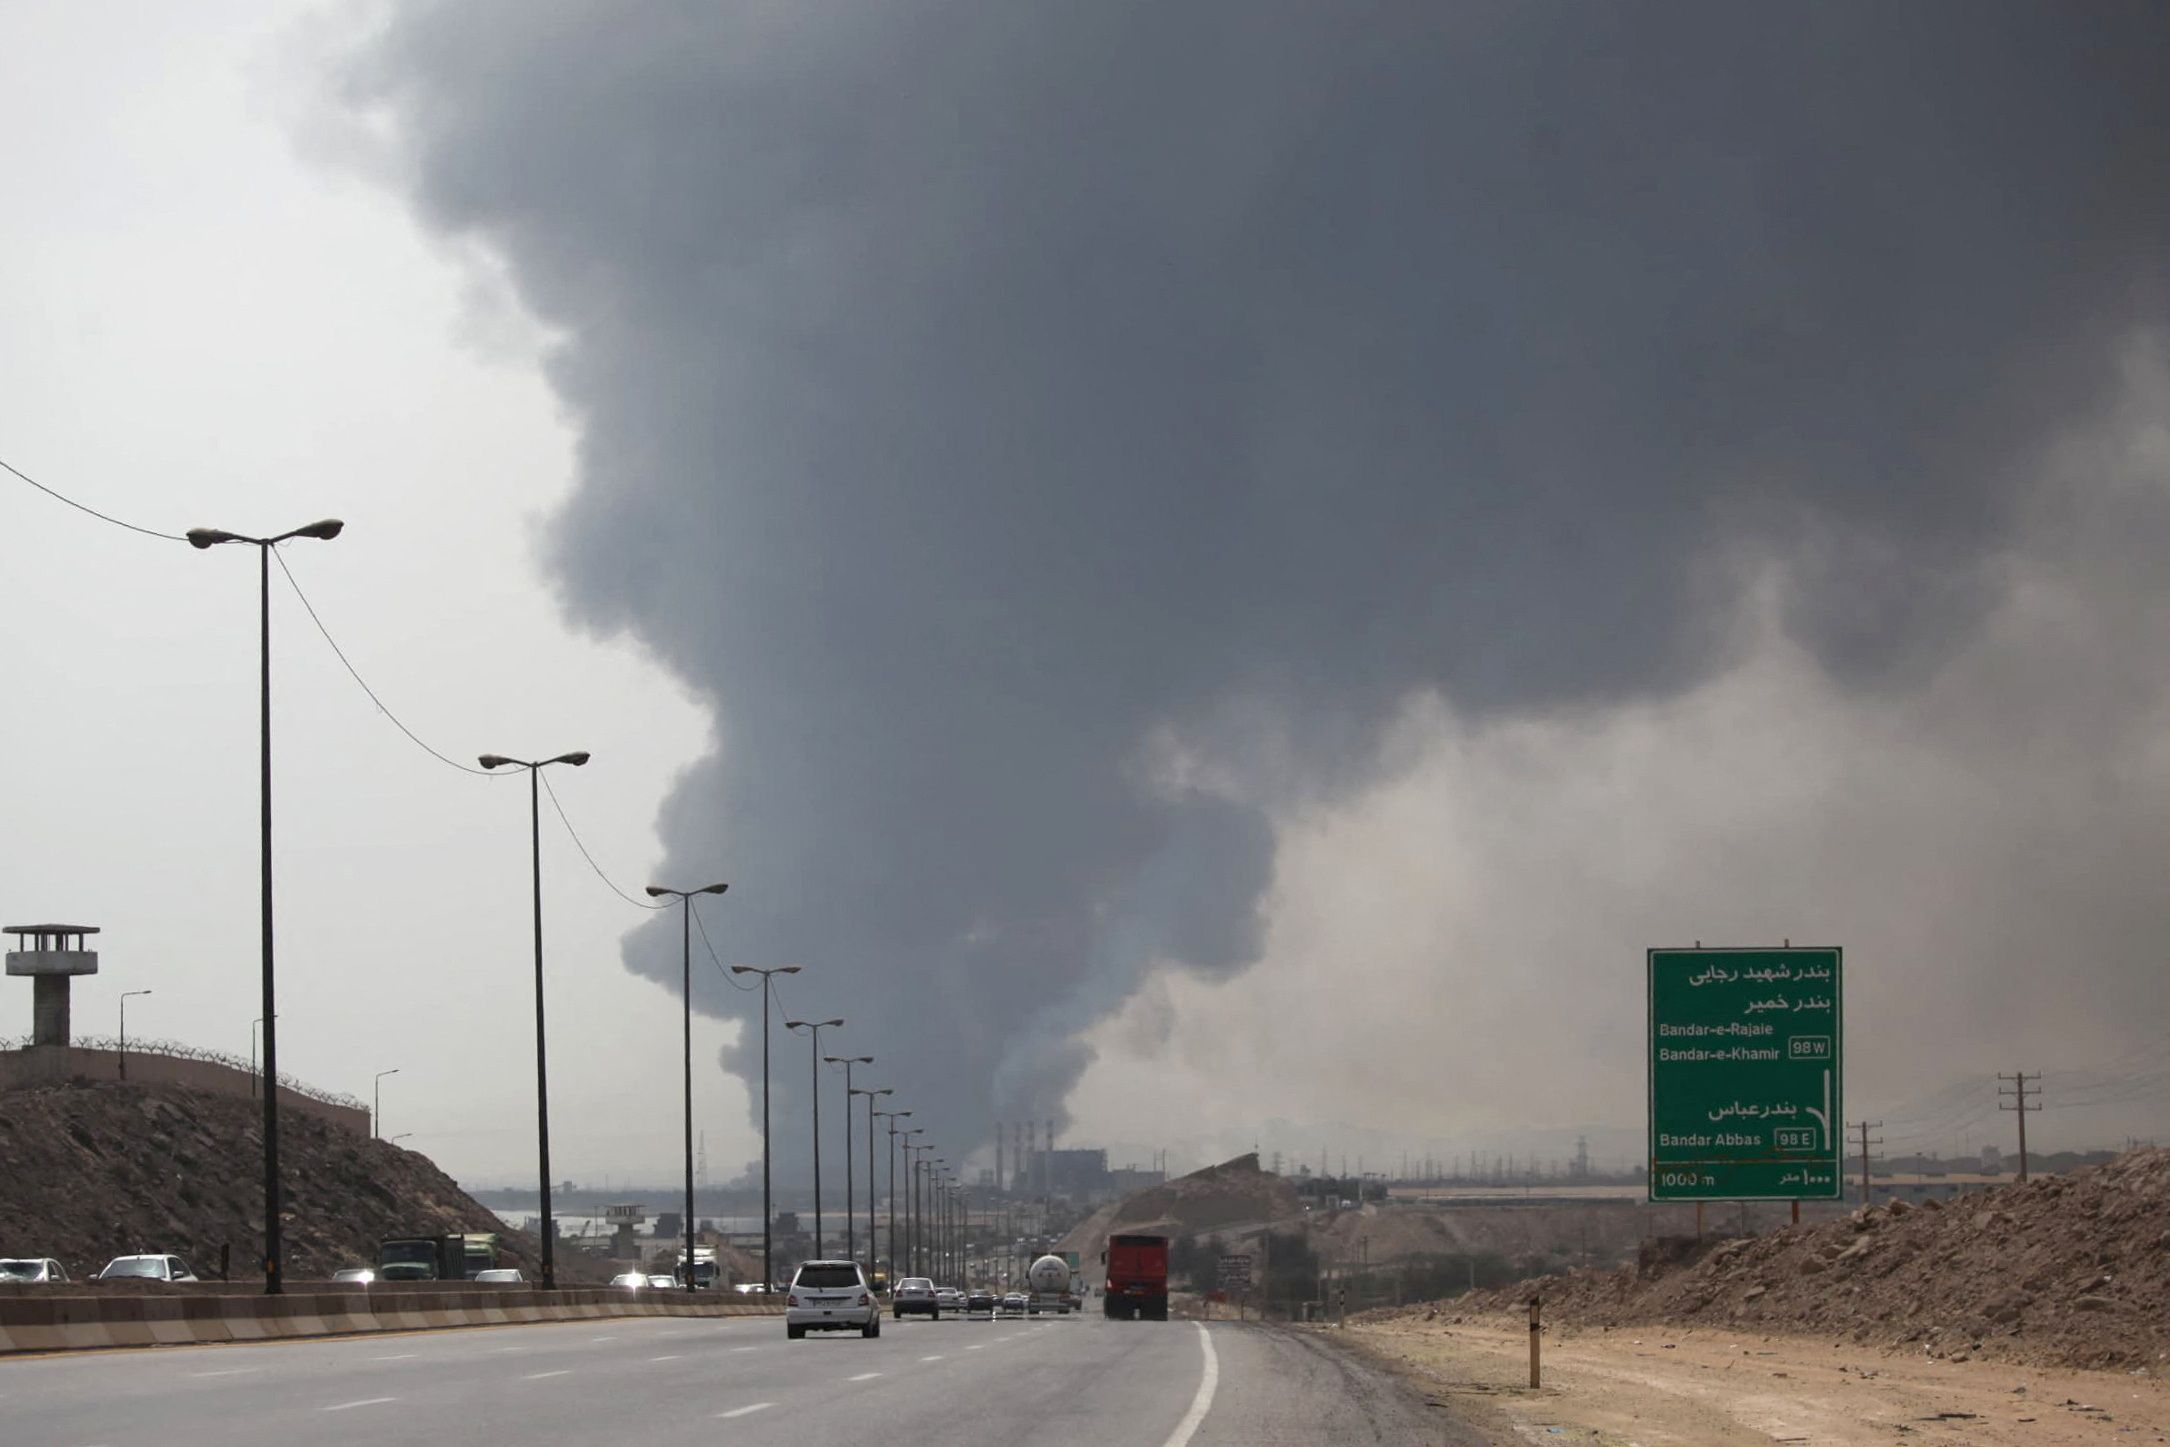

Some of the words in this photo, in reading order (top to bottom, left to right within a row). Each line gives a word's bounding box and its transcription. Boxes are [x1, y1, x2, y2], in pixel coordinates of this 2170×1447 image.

[1689, 965, 1739, 986] رجایی
[1743, 963, 1791, 983] شهید
[1793, 963, 1831, 983] بندر
[1744, 994, 1790, 1014] خمیر
[1793, 995, 1831, 1014] بندر
[1659, 1022, 1774, 1037] Bandar-e-Rajaie
[1659, 1047, 1780, 1061] Bandar-e-Khamir
[1659, 1133, 1711, 1147] Bandar
[1714, 1132, 1762, 1146] Abbas
[1661, 1173, 1698, 1187] 1000
[1779, 1174, 1800, 1185] متر
